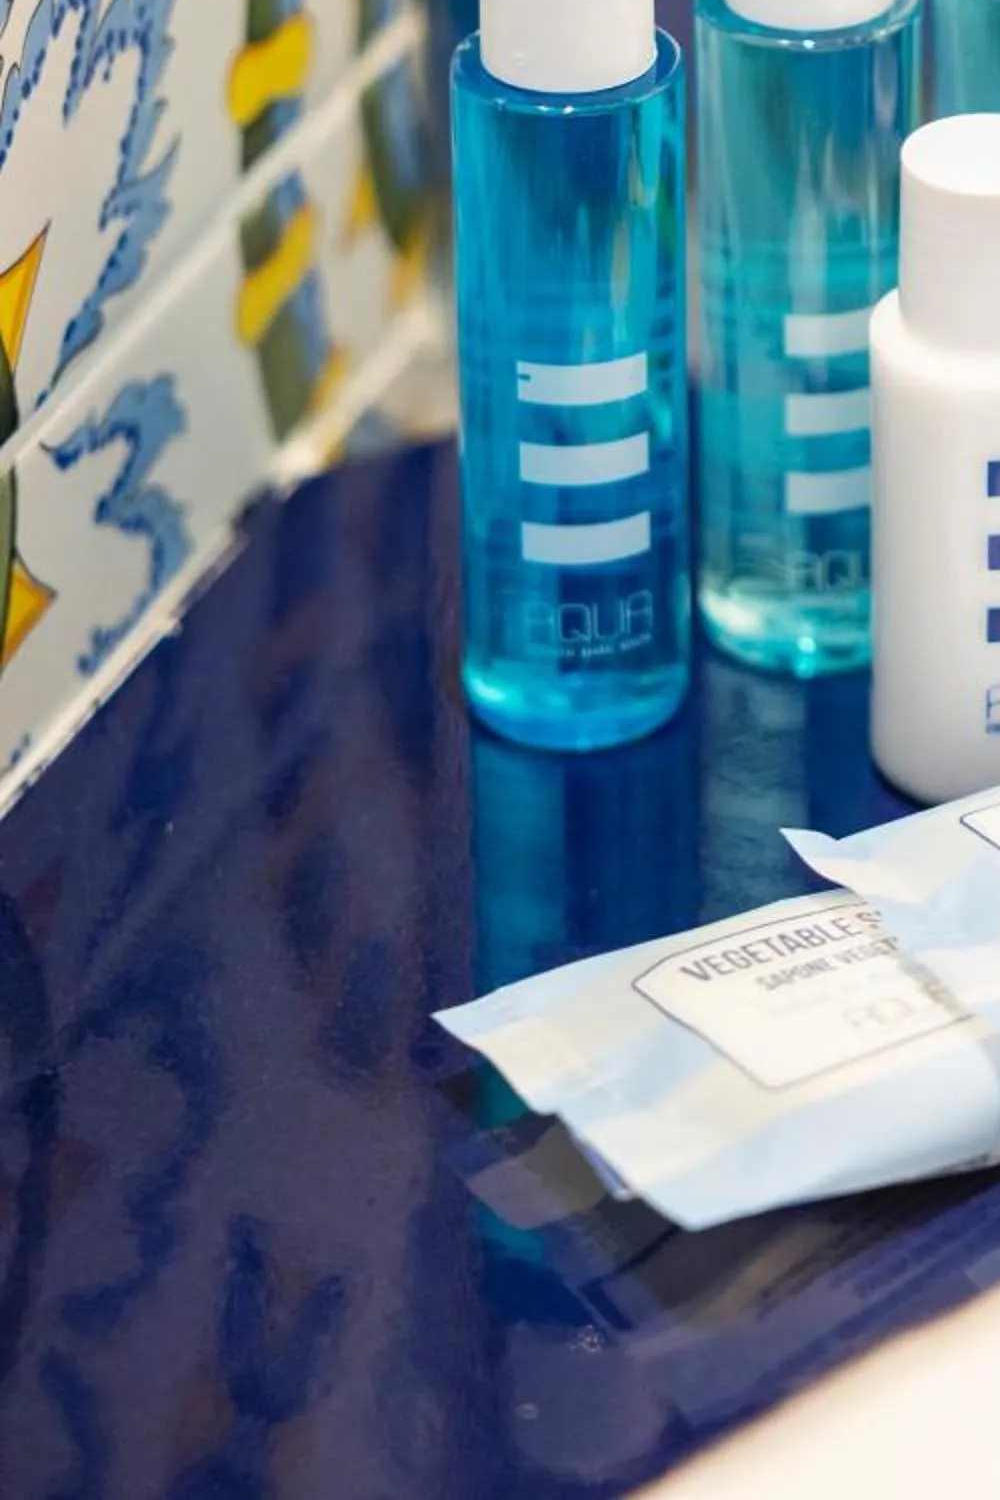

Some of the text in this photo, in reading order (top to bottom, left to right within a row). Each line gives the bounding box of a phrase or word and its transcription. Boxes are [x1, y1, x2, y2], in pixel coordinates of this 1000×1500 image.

[521, 588, 654, 645] AQUA
[679, 916, 864, 982] VEGETABLE
[755, 935, 900, 993] SAPONE VEGET
